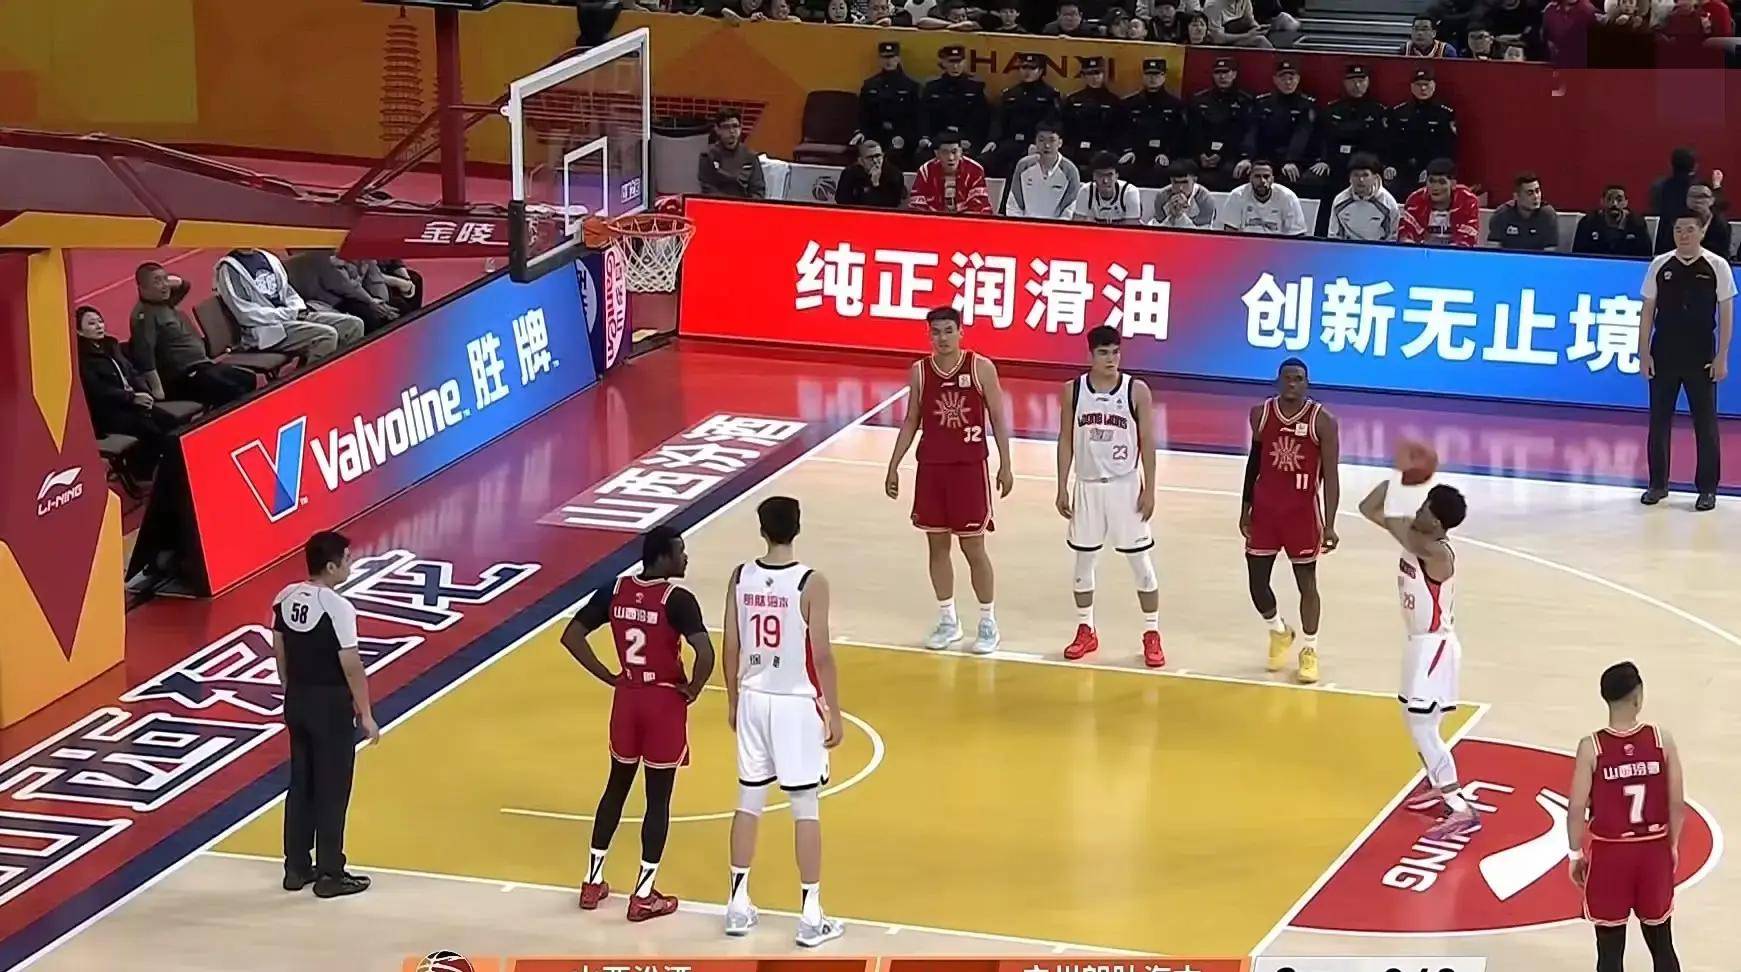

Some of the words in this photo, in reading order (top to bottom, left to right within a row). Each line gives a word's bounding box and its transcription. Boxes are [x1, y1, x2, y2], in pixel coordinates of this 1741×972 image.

[420, 221, 496, 244] 金陵
[795, 239, 1172, 341] 纯正润滑油
[1241, 271, 1643, 375] 创新无止境
[309, 379, 463, 492] Valvoline
[466, 307, 553, 410] 胜牌
[1112, 444, 1128, 460] 23
[562, 414, 808, 529] 山西汾酒
[1296, 473, 1309, 490] 11
[37, 483, 83, 516] LI-NING
[291, 603, 309, 625] 58
[750, 613, 781, 649] 19
[625, 627, 647, 665] 2
[1623, 784, 1646, 824] 7
